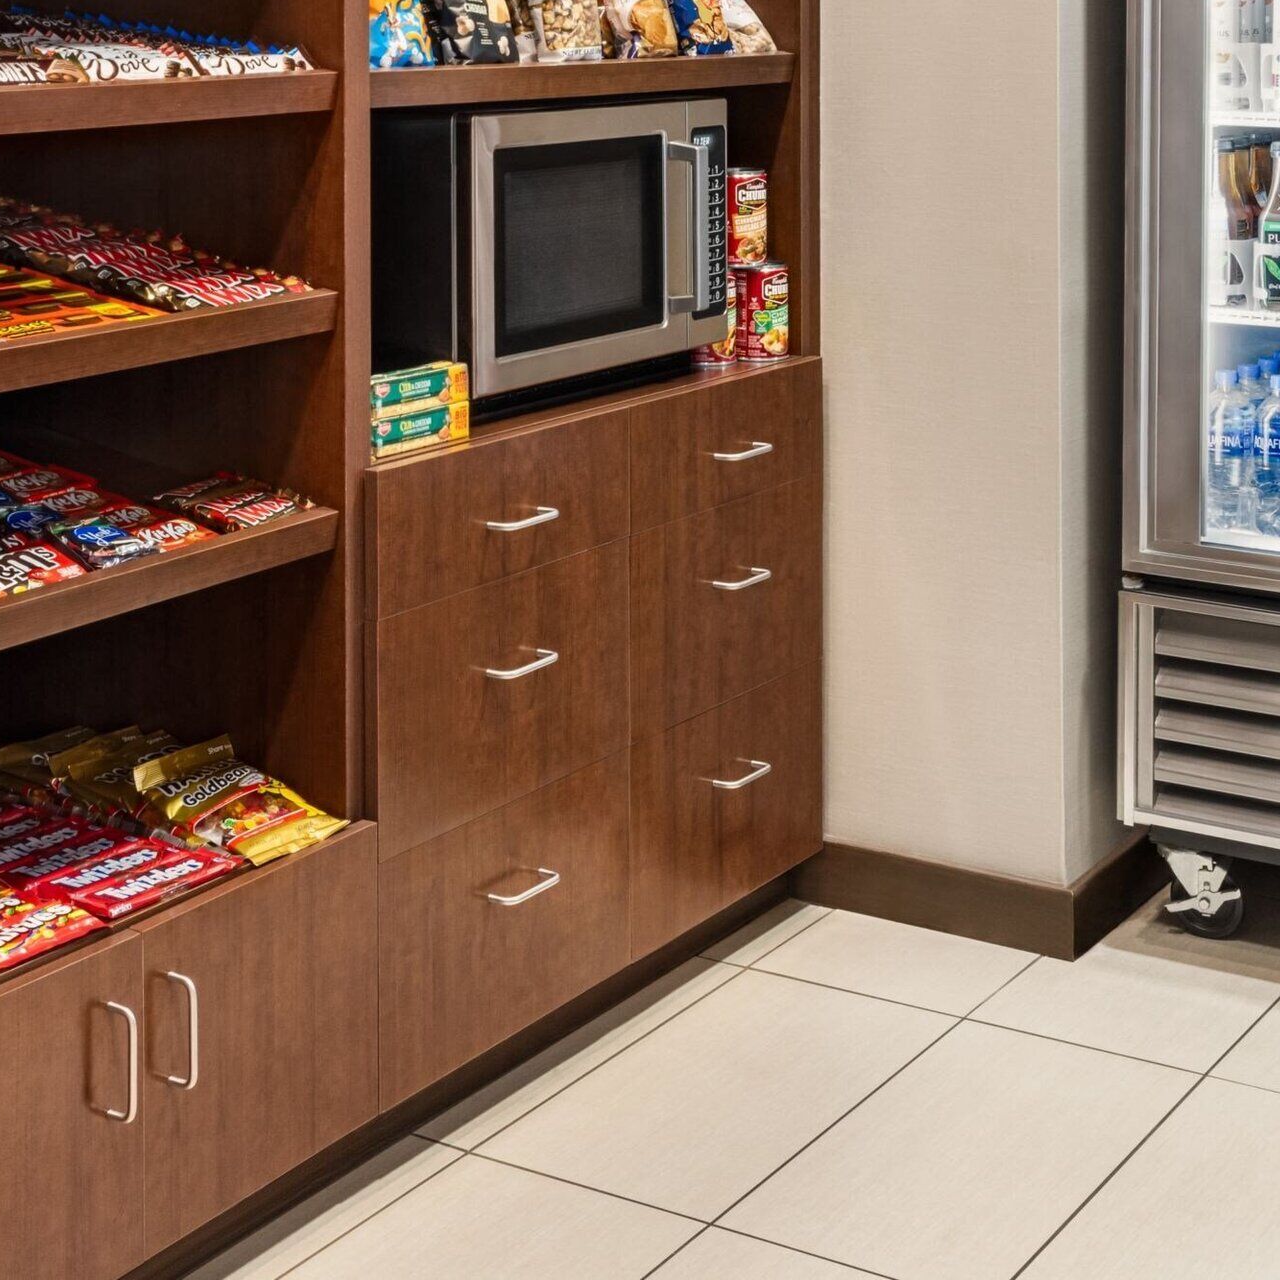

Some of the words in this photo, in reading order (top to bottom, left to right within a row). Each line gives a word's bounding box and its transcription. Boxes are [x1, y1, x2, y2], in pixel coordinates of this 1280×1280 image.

[88, 48, 159, 81] Dove
[224, 52, 279, 77] Dove
[75, 526, 118, 548] York
[51, 848, 159, 888] Twizzlers
[97, 858, 204, 899] Twizzlers
